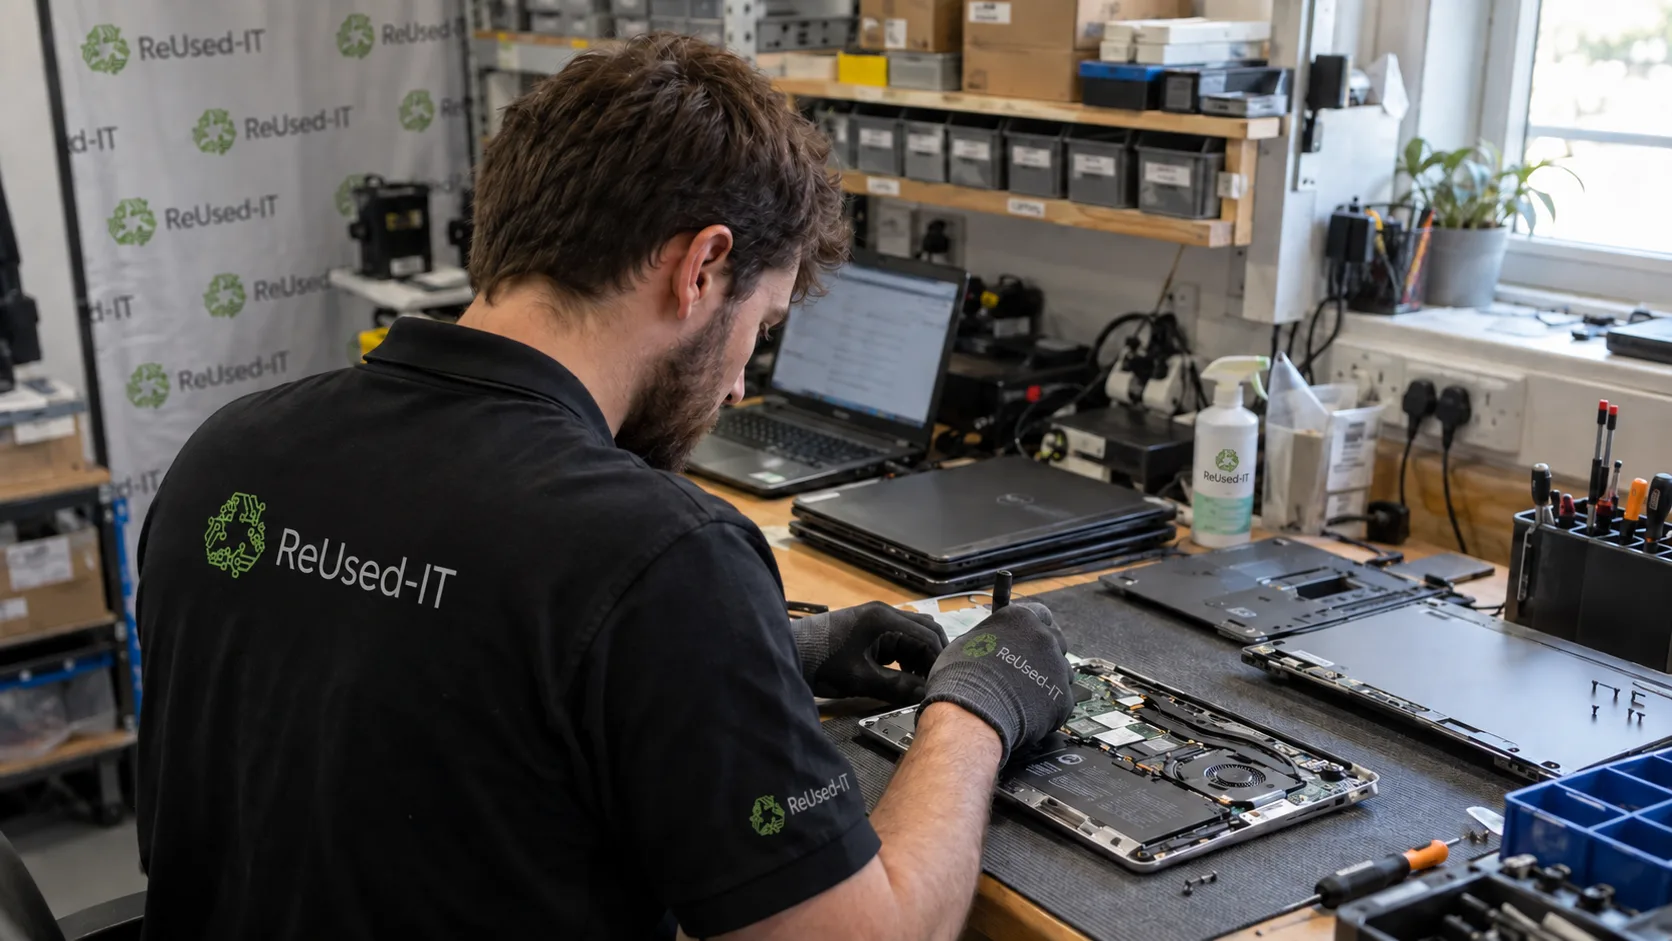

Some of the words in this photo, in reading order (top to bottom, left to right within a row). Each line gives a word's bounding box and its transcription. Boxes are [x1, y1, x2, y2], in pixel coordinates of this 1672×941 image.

[138, 29, 266, 61] ReUsed-IT
[244, 106, 353, 141] ReUsed-IT
[165, 195, 279, 231] ReUsed-IT
[178, 350, 290, 391] ReUsed-IT
[1203, 470, 1250, 484] ReUsed-IT
[275, 527, 458, 609] ReUsed-IT
[995, 646, 1064, 701] ReUsed-IT
[786, 772, 850, 816] ReUsed-IT
